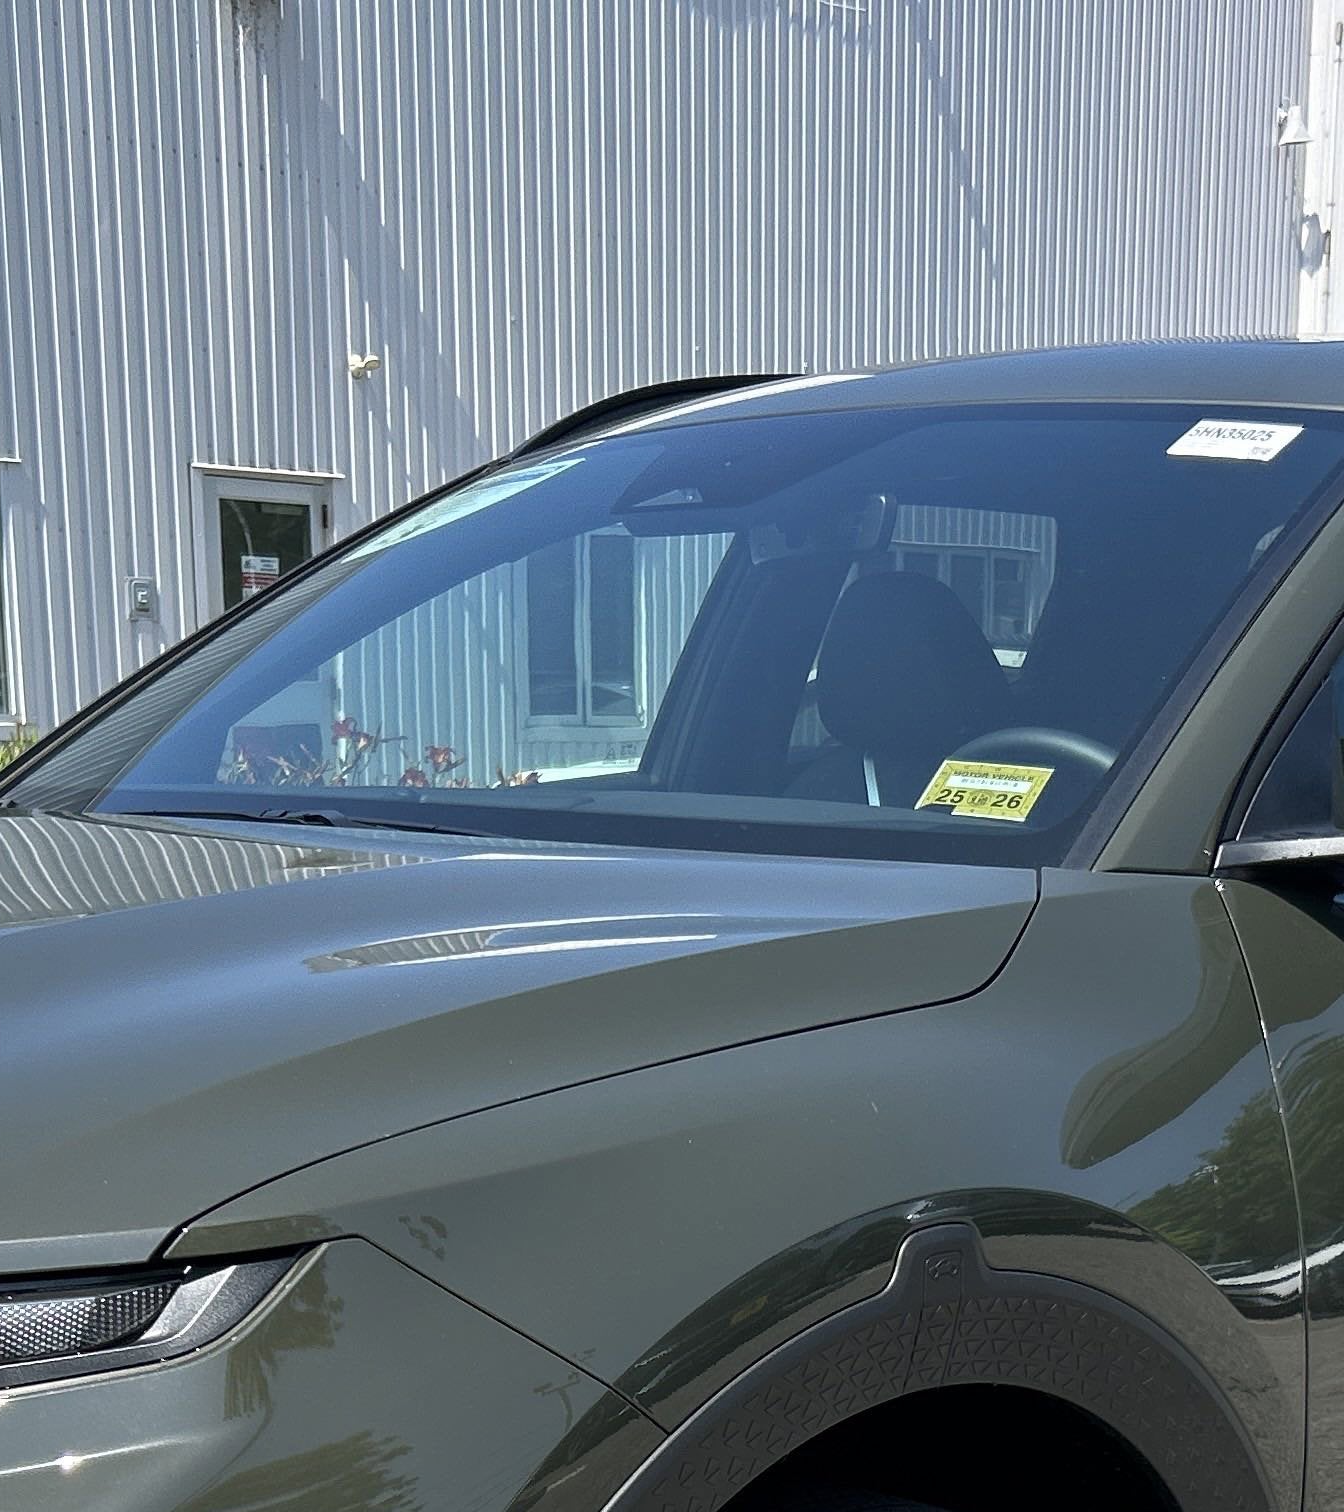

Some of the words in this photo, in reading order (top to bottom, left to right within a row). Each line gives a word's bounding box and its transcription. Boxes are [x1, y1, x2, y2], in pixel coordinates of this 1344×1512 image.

[992, 774, 1034, 782] VEHICLE
[935, 788, 967, 804] 25
[990, 794, 1023, 809] 26
